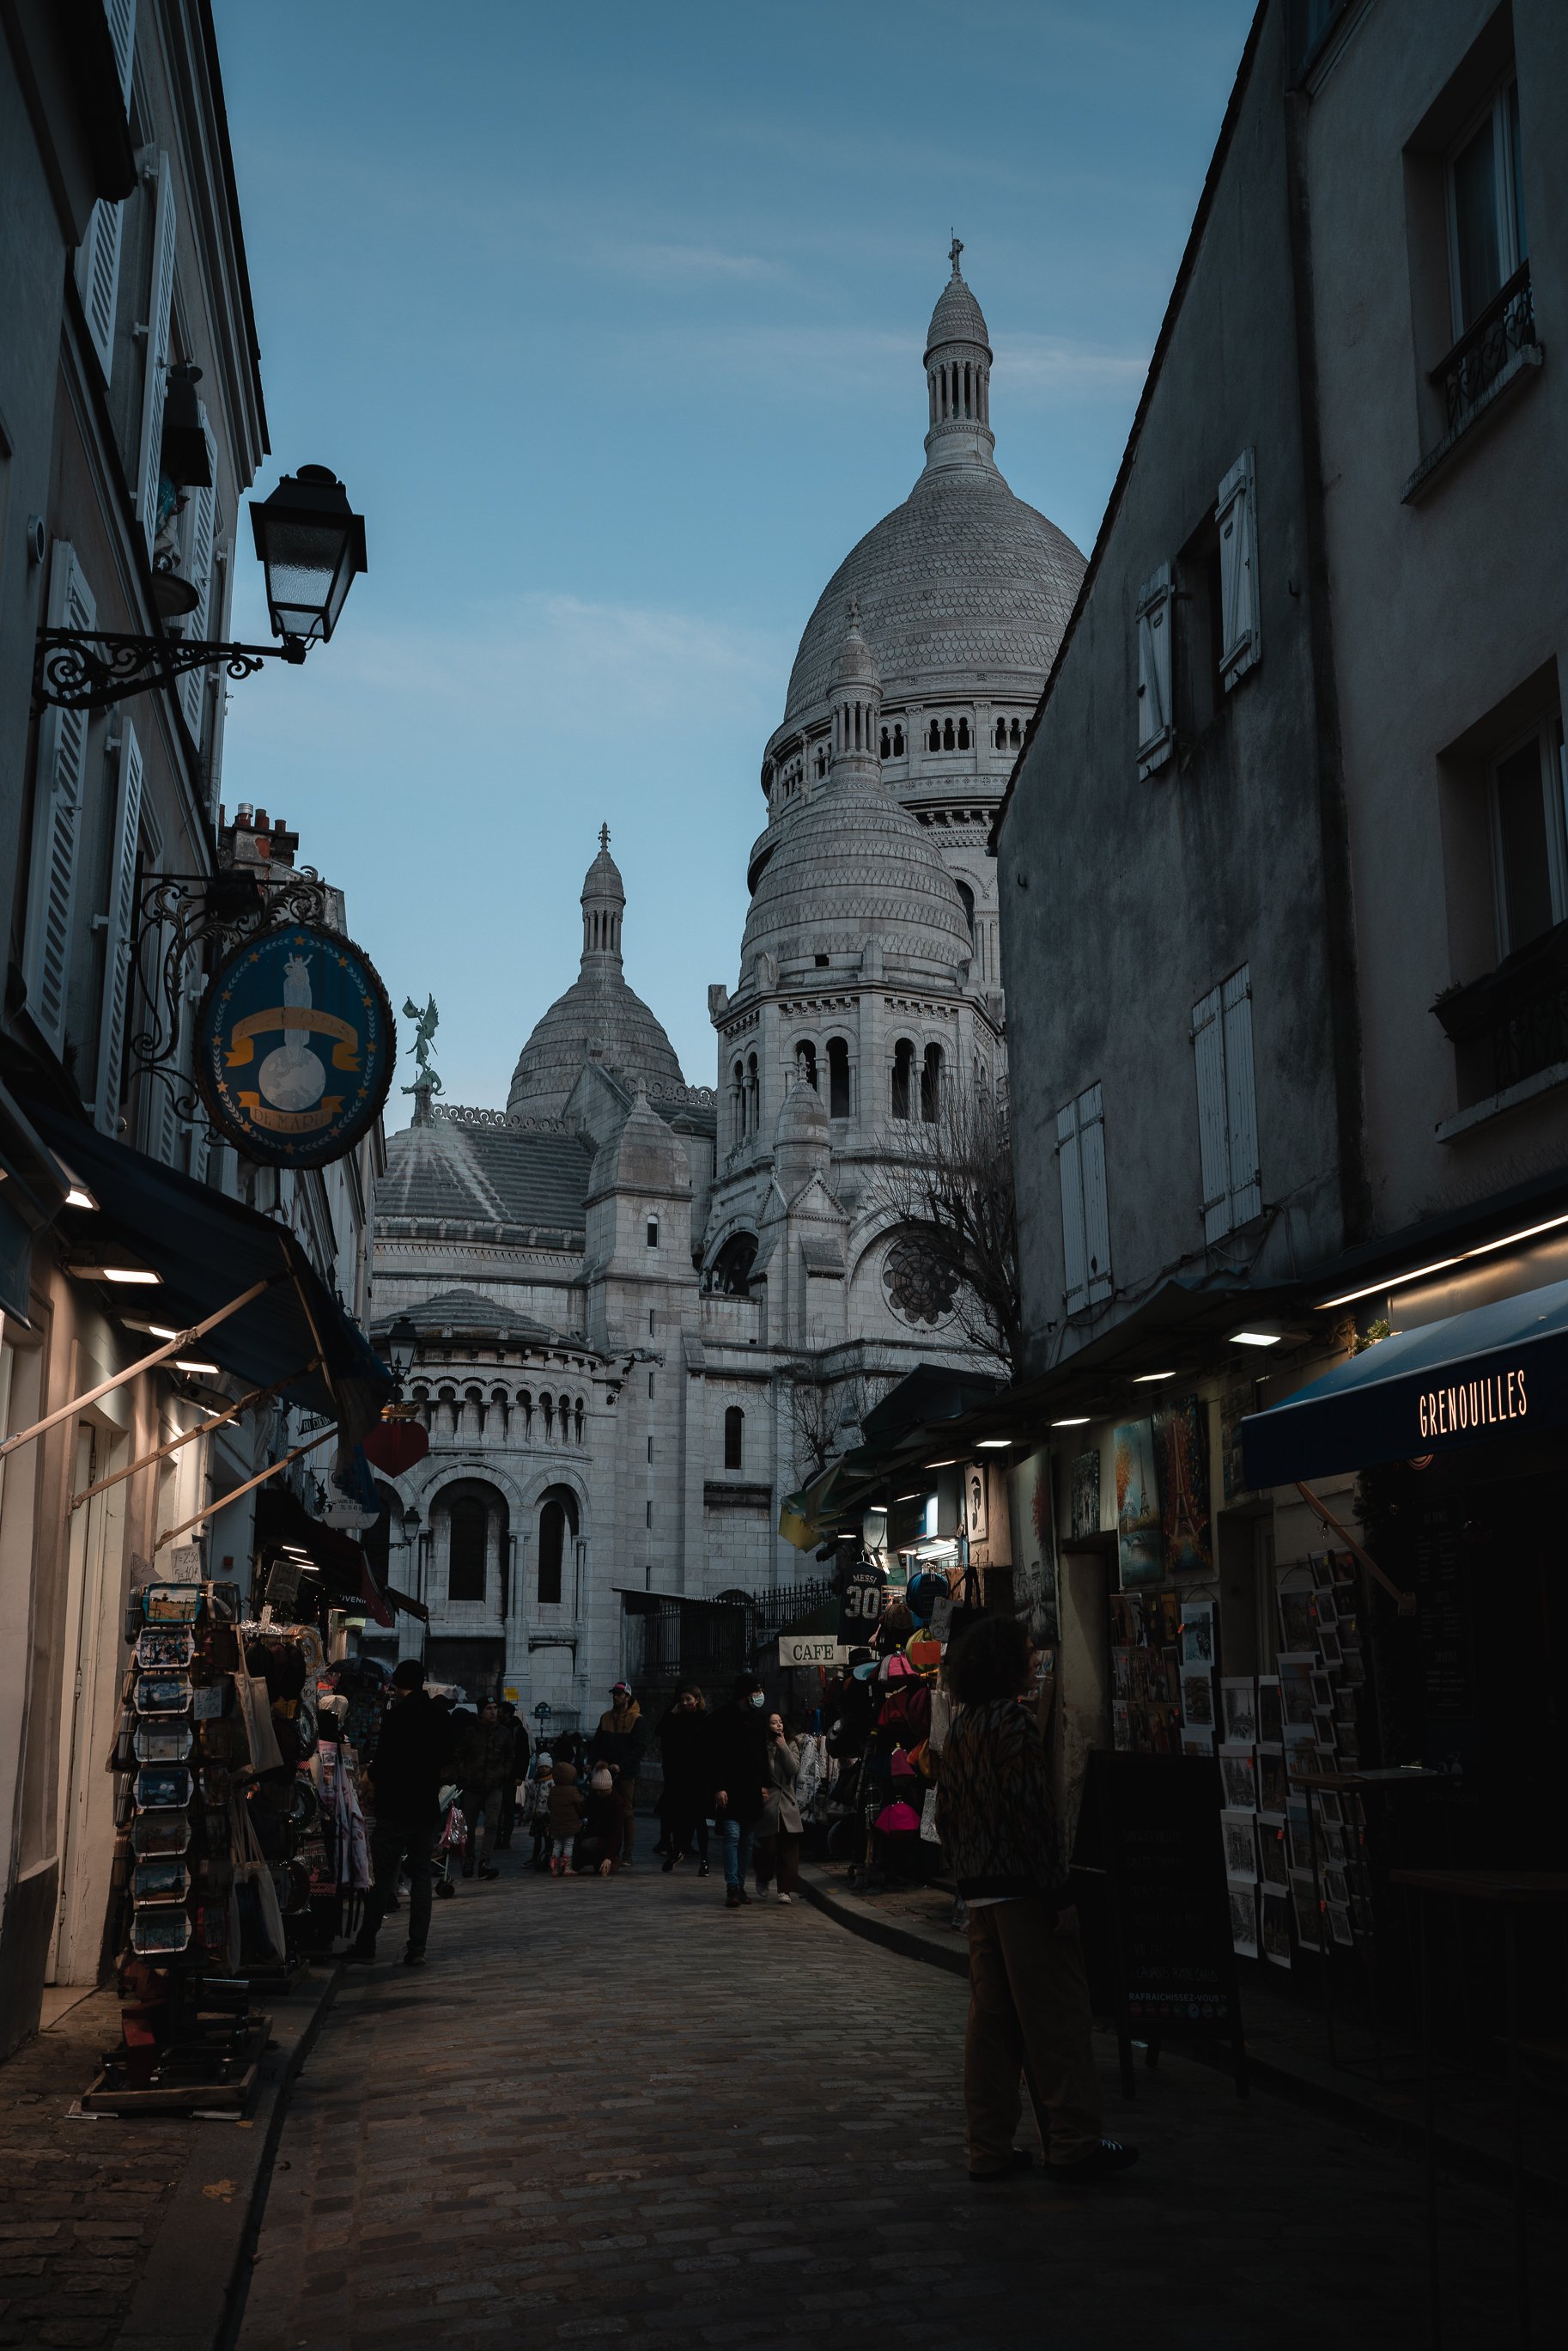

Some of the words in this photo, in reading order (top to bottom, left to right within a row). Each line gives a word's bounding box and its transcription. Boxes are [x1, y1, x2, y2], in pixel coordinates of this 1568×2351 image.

[254, 1109, 271, 1126] DE
[1419, 1369, 1528, 1438] GRENOUILLES
[303, 1420, 312, 1432] AU
[852, 1574, 878, 1585] MESSI
[844, 1585, 880, 1620] 30
[793, 1644, 834, 1661] CAFE
